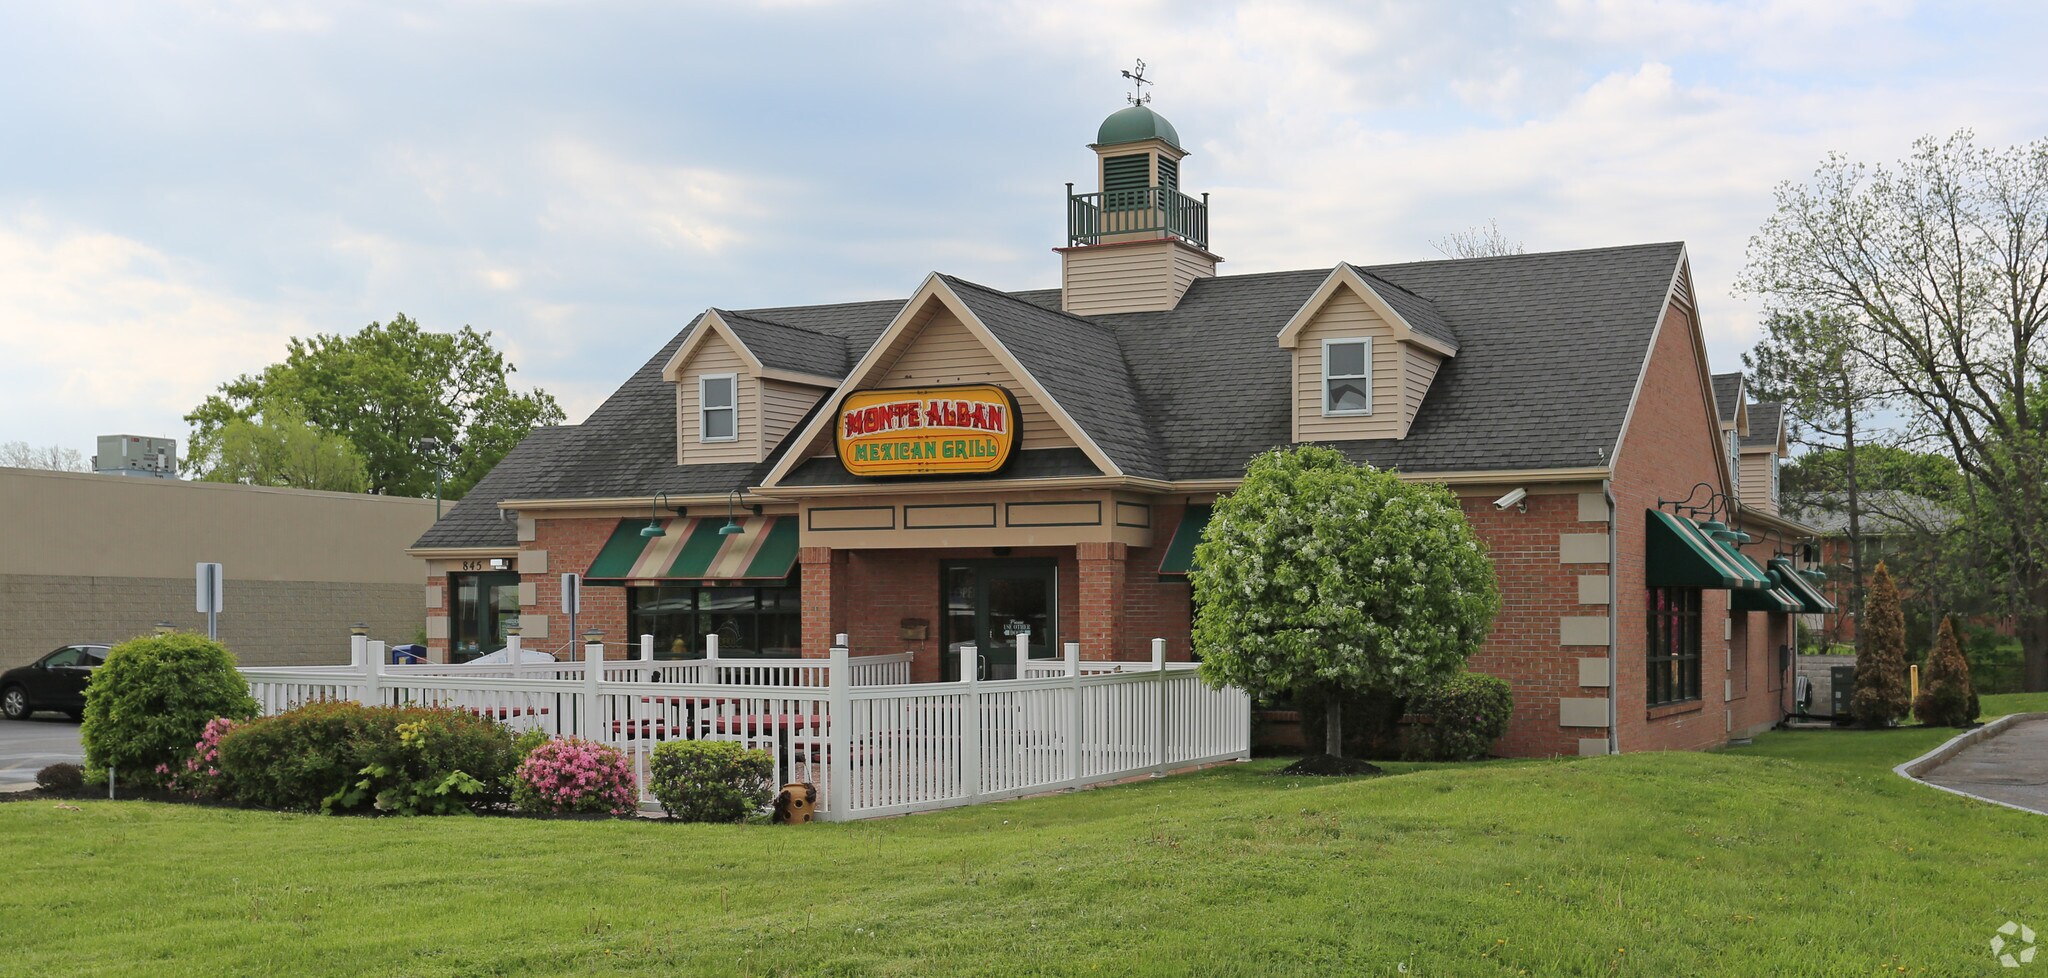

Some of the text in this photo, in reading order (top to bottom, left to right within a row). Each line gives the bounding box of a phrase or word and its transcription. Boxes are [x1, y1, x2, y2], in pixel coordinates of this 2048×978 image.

[845, 400, 1004, 438] MONTE ALBAN
[854, 438, 997, 462] MEXICAN GRILL
[462, 560, 482, 570] 845
